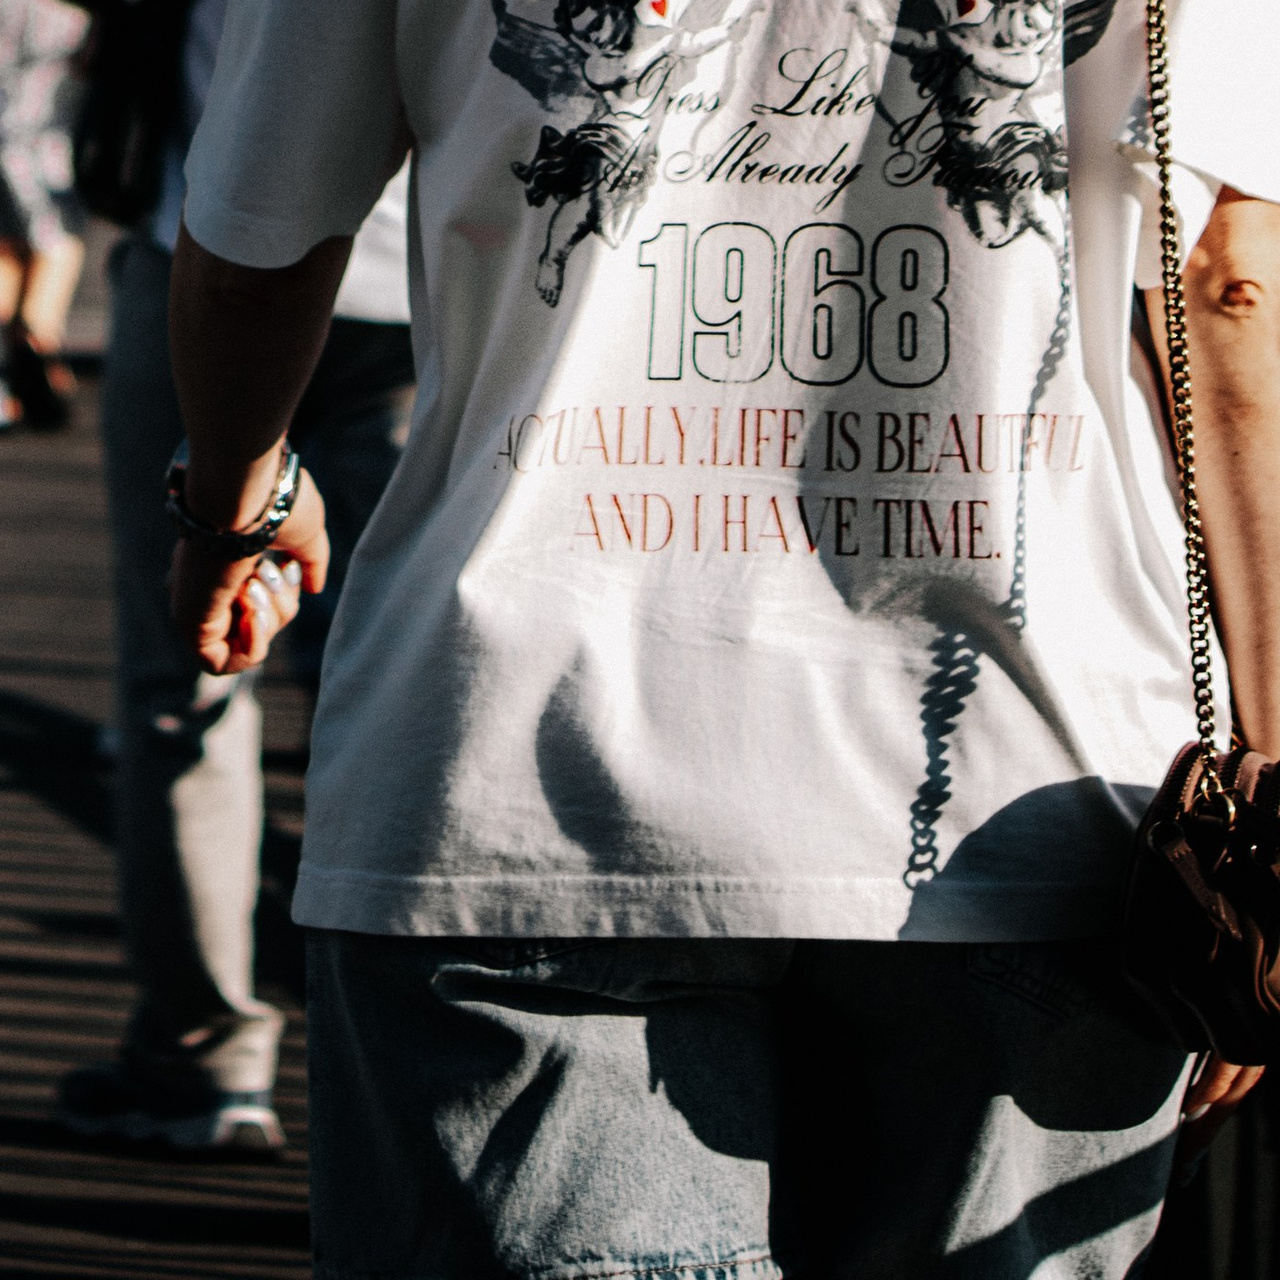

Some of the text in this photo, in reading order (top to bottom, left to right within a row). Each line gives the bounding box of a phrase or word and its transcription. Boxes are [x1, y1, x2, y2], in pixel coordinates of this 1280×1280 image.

[751, 47, 877, 117] Like
[663, 120, 863, 214] Already
[637, 222, 950, 388] 1968
[822, 411, 861, 473] IS
[570, 493, 1002, 560] AND I HAVE TIME.
